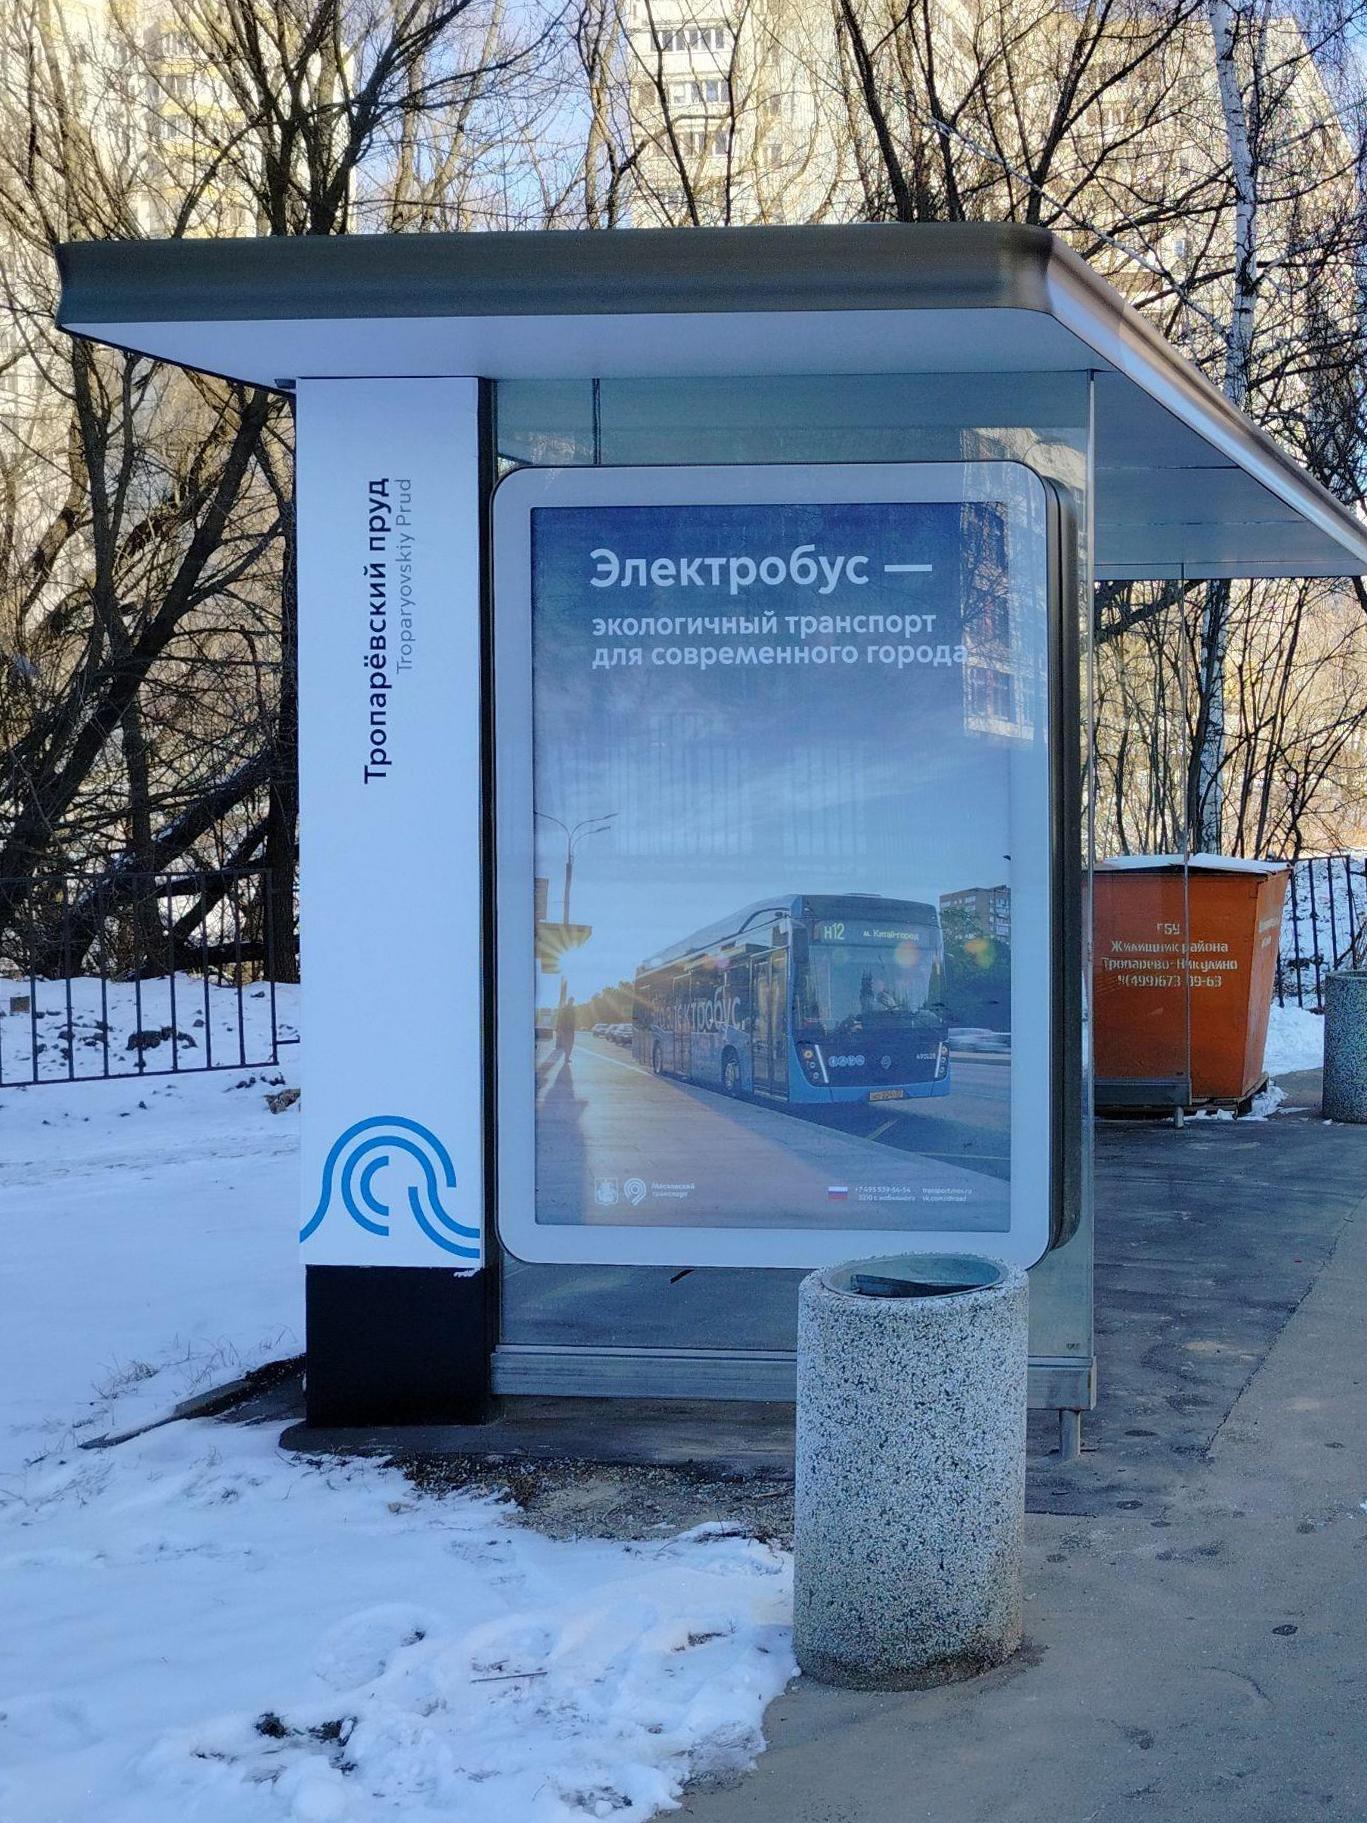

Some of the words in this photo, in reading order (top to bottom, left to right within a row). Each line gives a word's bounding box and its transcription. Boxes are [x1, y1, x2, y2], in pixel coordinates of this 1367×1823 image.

[369, 478, 391, 551] пруд
[395, 478, 412, 526] Prud
[589, 544, 869, 594] Электробус
[395, 532, 416, 674] Troparyovskiy
[592, 610, 778, 636] экологичный
[785, 612, 936, 638] транспорт
[363, 563, 392, 784] Тропарёвский
[592, 645, 643, 669] для
[651, 643, 858, 669] современного
[867, 642, 967, 667] города
[1111, 941, 1180, 953] Жилищник
[1182, 940, 1229, 954] района
